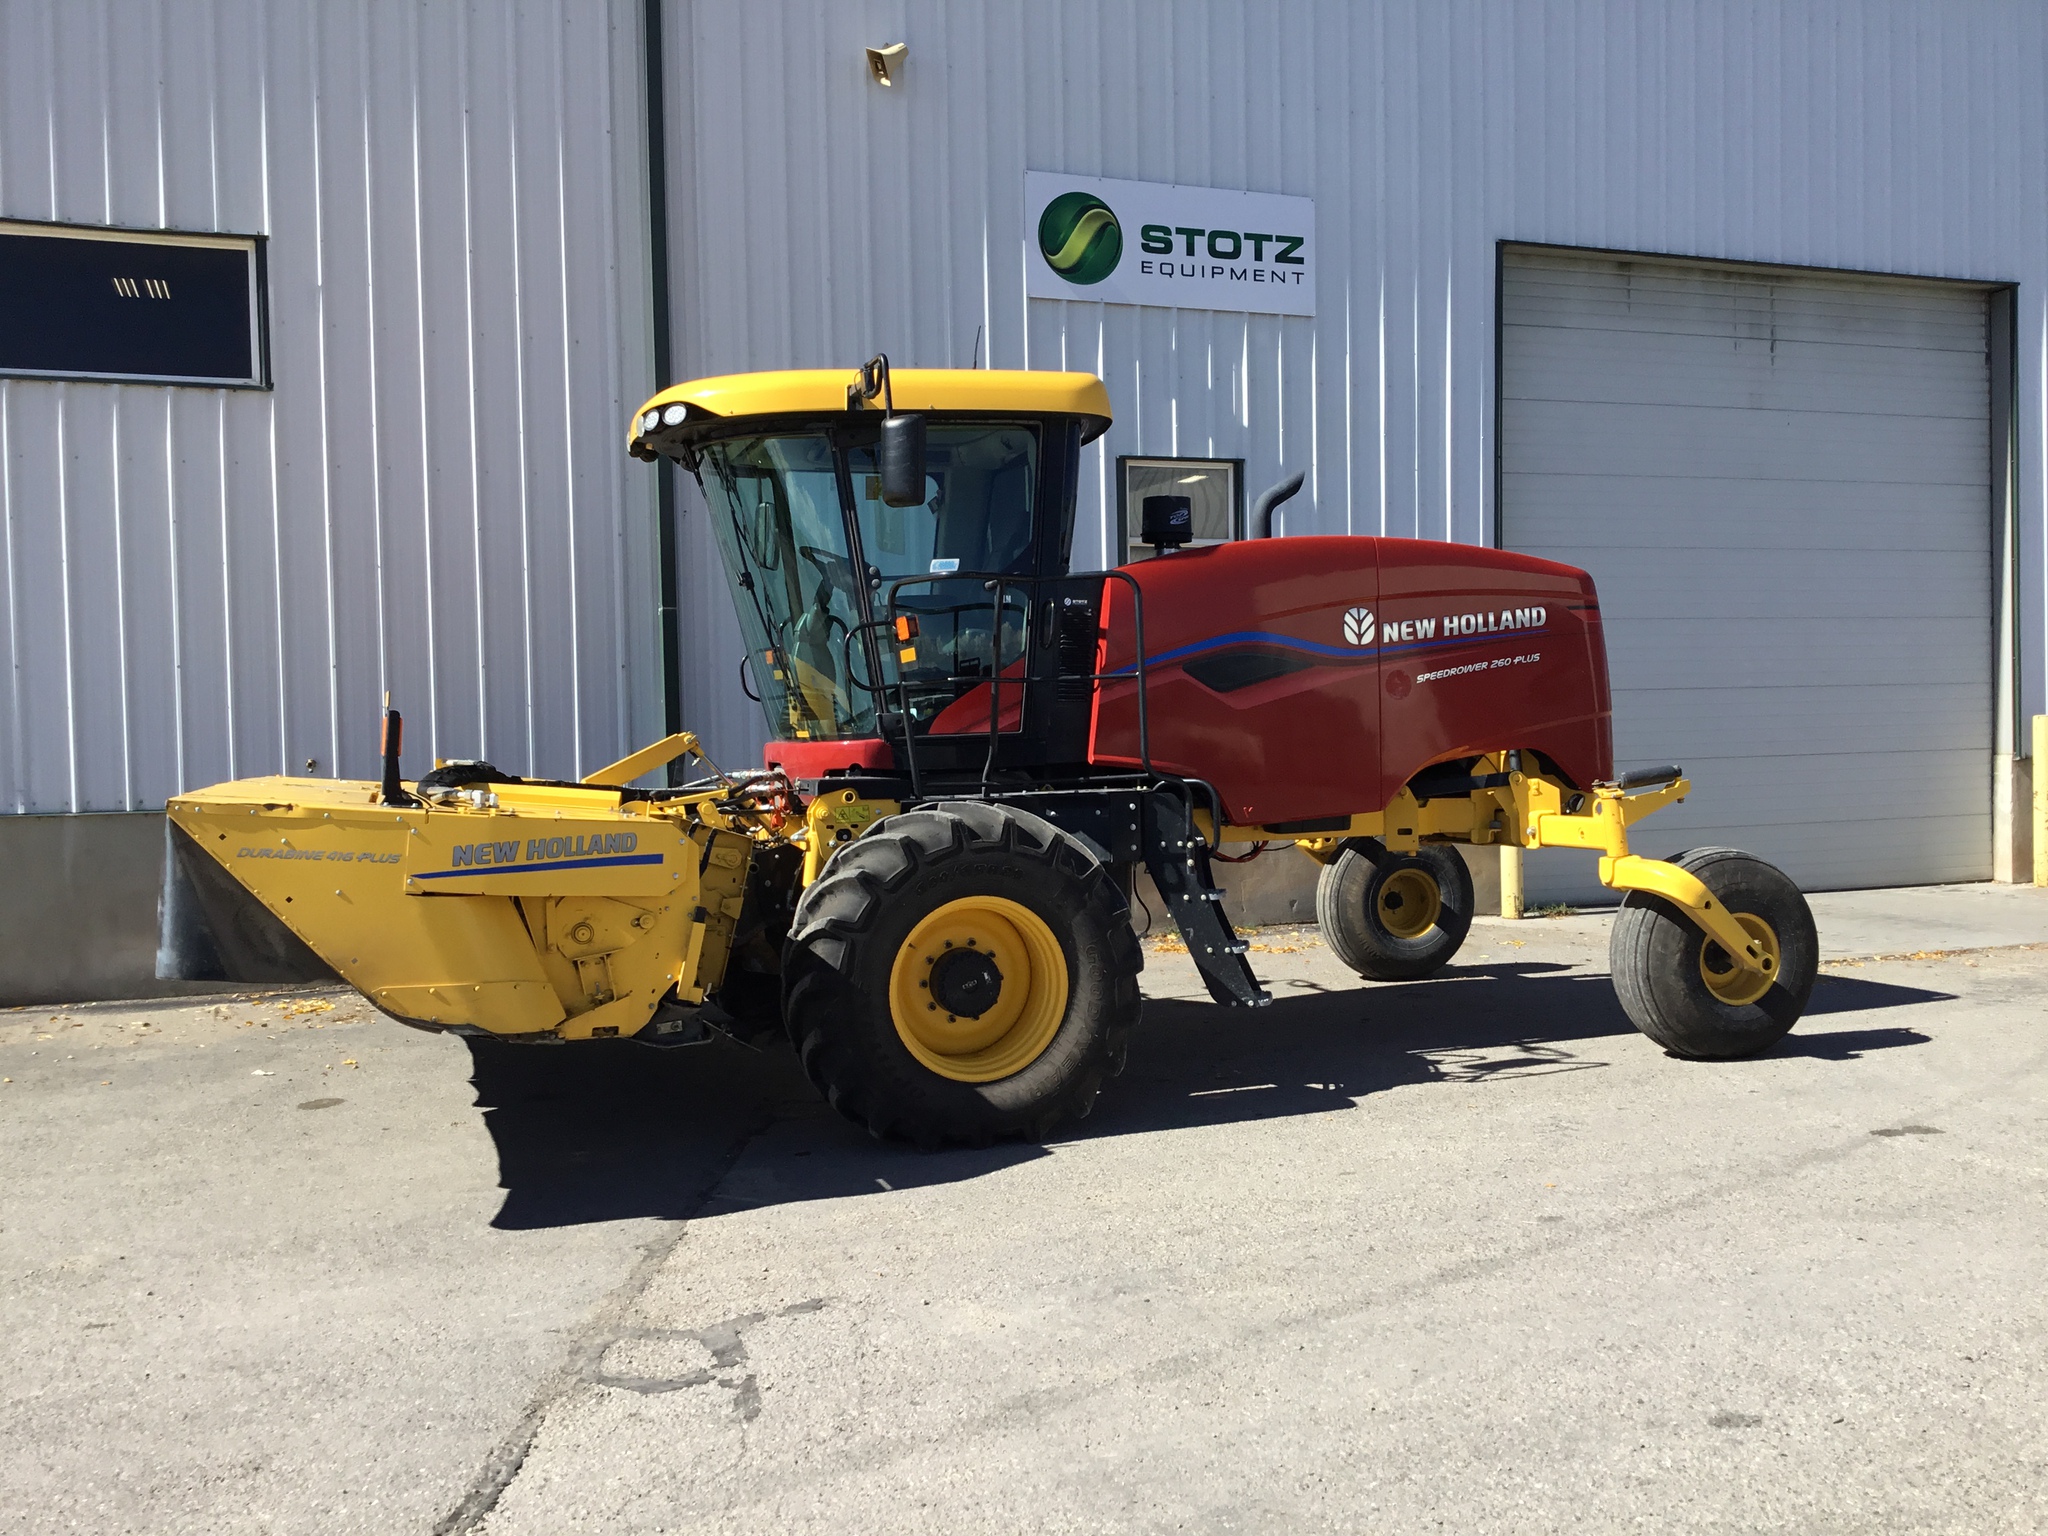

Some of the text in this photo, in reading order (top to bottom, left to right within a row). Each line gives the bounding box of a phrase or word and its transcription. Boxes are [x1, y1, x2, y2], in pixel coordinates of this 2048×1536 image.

[1140, 223, 1305, 265] STOTZ
[1140, 260, 1305, 285] EQUIPMENT
[1382, 606, 1546, 643] NEW HOLLAND
[1416, 653, 1541, 684] SPEEDROWER 260 PLUS
[236, 847, 402, 864] DURABINE 416 PLUS
[452, 832, 637, 867] NEW HOLLAND
